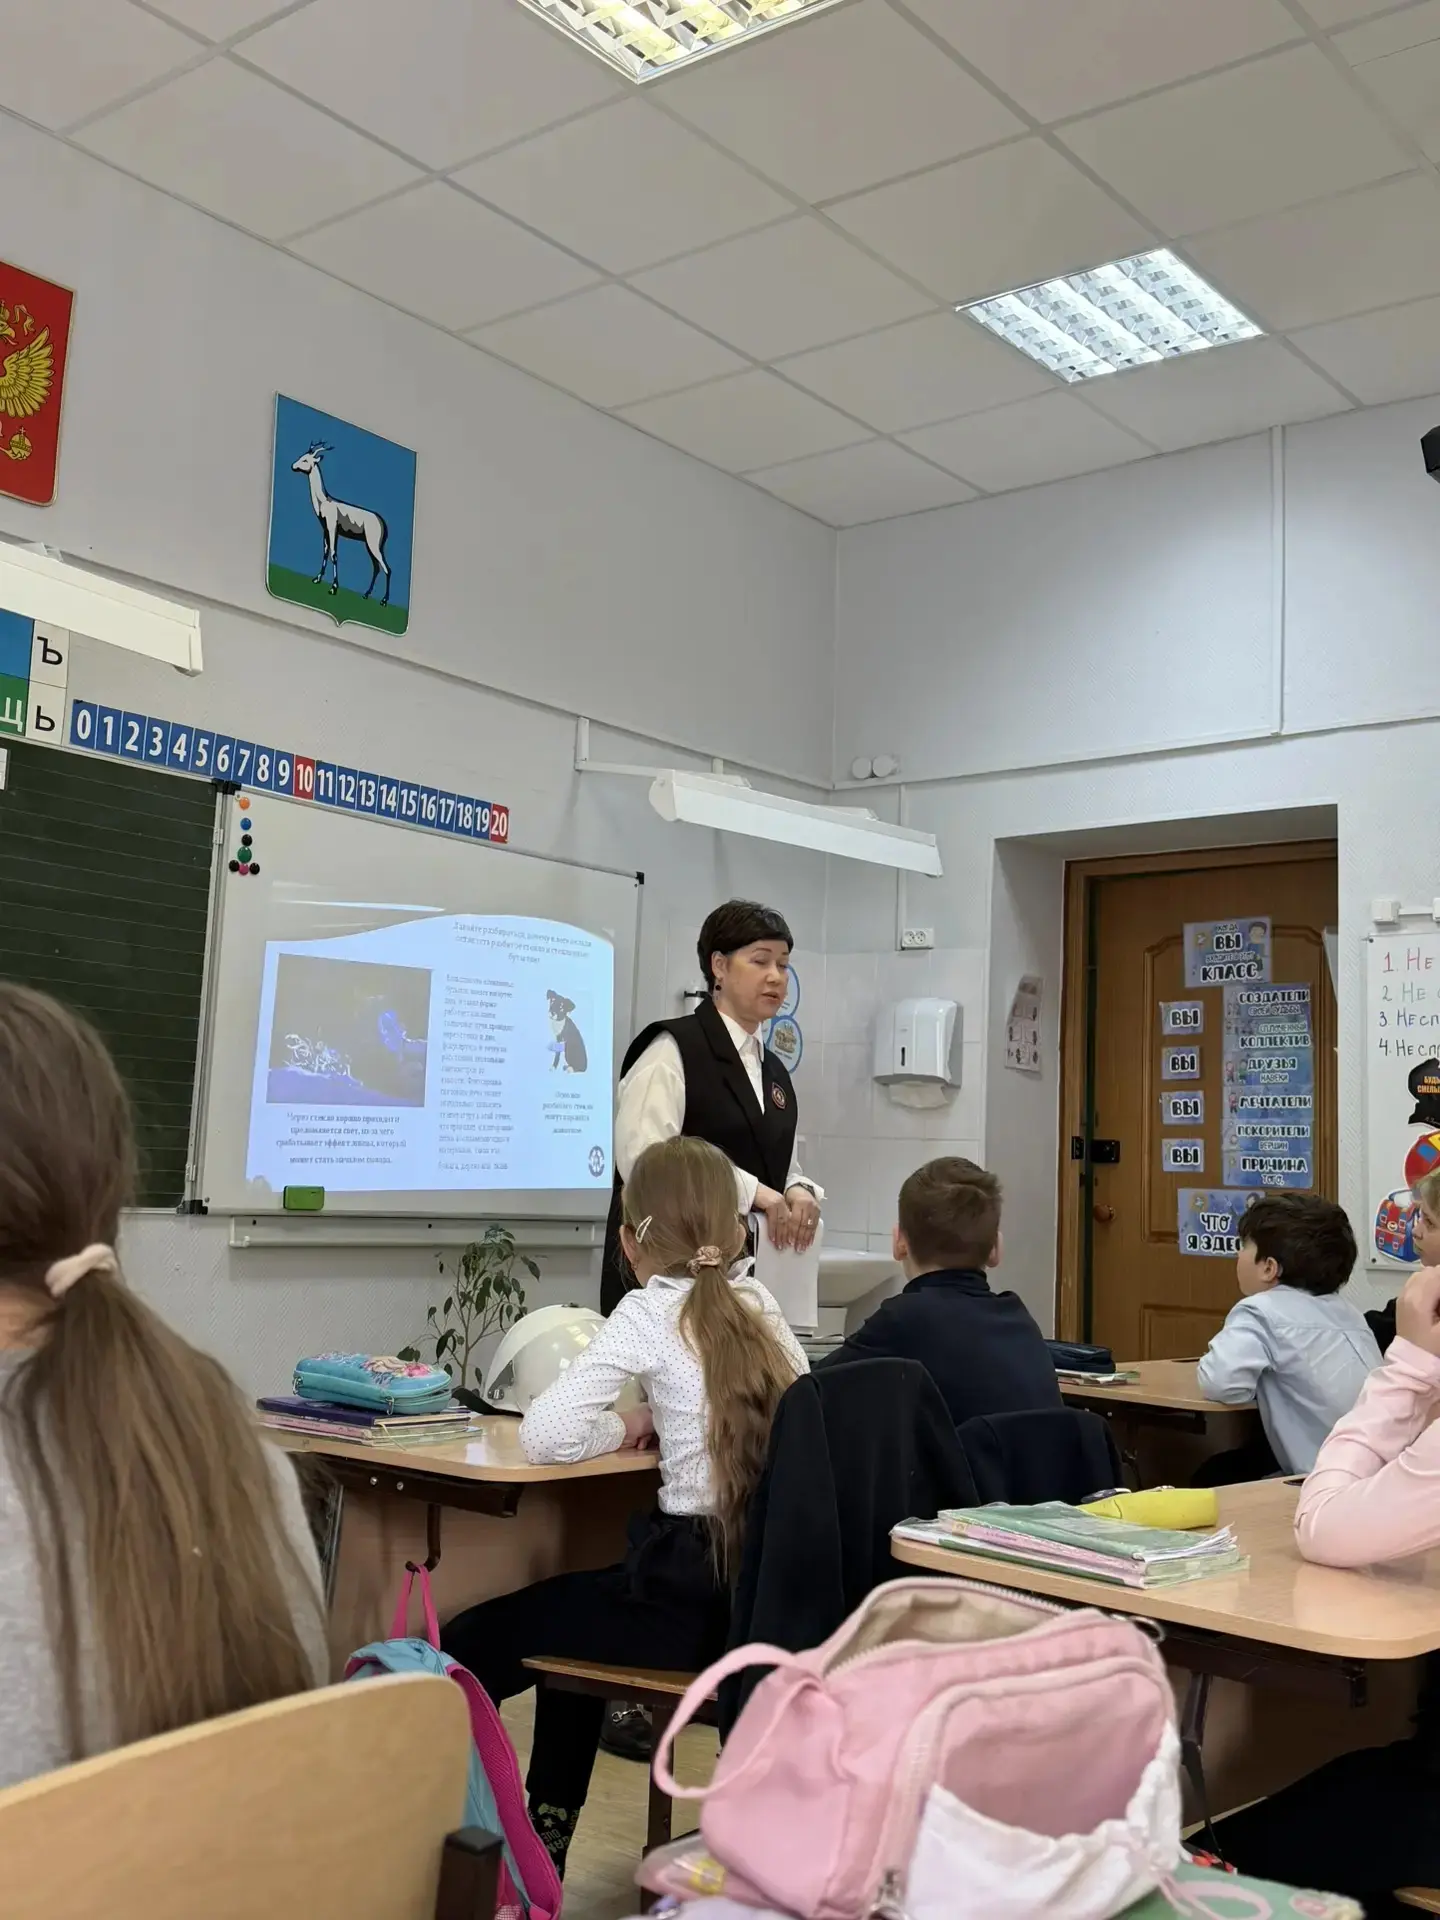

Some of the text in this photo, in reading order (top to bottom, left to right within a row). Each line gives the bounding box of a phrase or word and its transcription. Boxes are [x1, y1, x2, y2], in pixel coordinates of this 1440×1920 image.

[77, 709, 507, 837] 0 1 2 3 4 5 6 7 8 9 10 11 12 13 14 15 16 17 18 19 20
[1214, 934, 1242, 950] ВЫ
[1201, 963, 1257, 981] КЛАСС
[1240, 990, 1309, 1003] СОЗДАТЕЛИ
[1171, 1010, 1199, 1026] ВЫ
[1240, 1035, 1309, 1047] КОЛЛЕКТИВ
[1171, 1056, 1196, 1071] ВЫ
[1248, 1058, 1297, 1070] ДРУЗЬЯ
[1171, 1101, 1199, 1116] ВЫ
[1239, 1096, 1311, 1108] МЕЧТАТЕЛИ
[1237, 1125, 1310, 1137] ПОКОРИТЕЛИ
[1172, 1148, 1199, 1164] ВЫ
[1241, 1158, 1307, 1172] ПРИЧИНА
[1201, 1213, 1230, 1231] ЧТО
[1187, 1234, 1241, 1252] Я ЗДЕ
